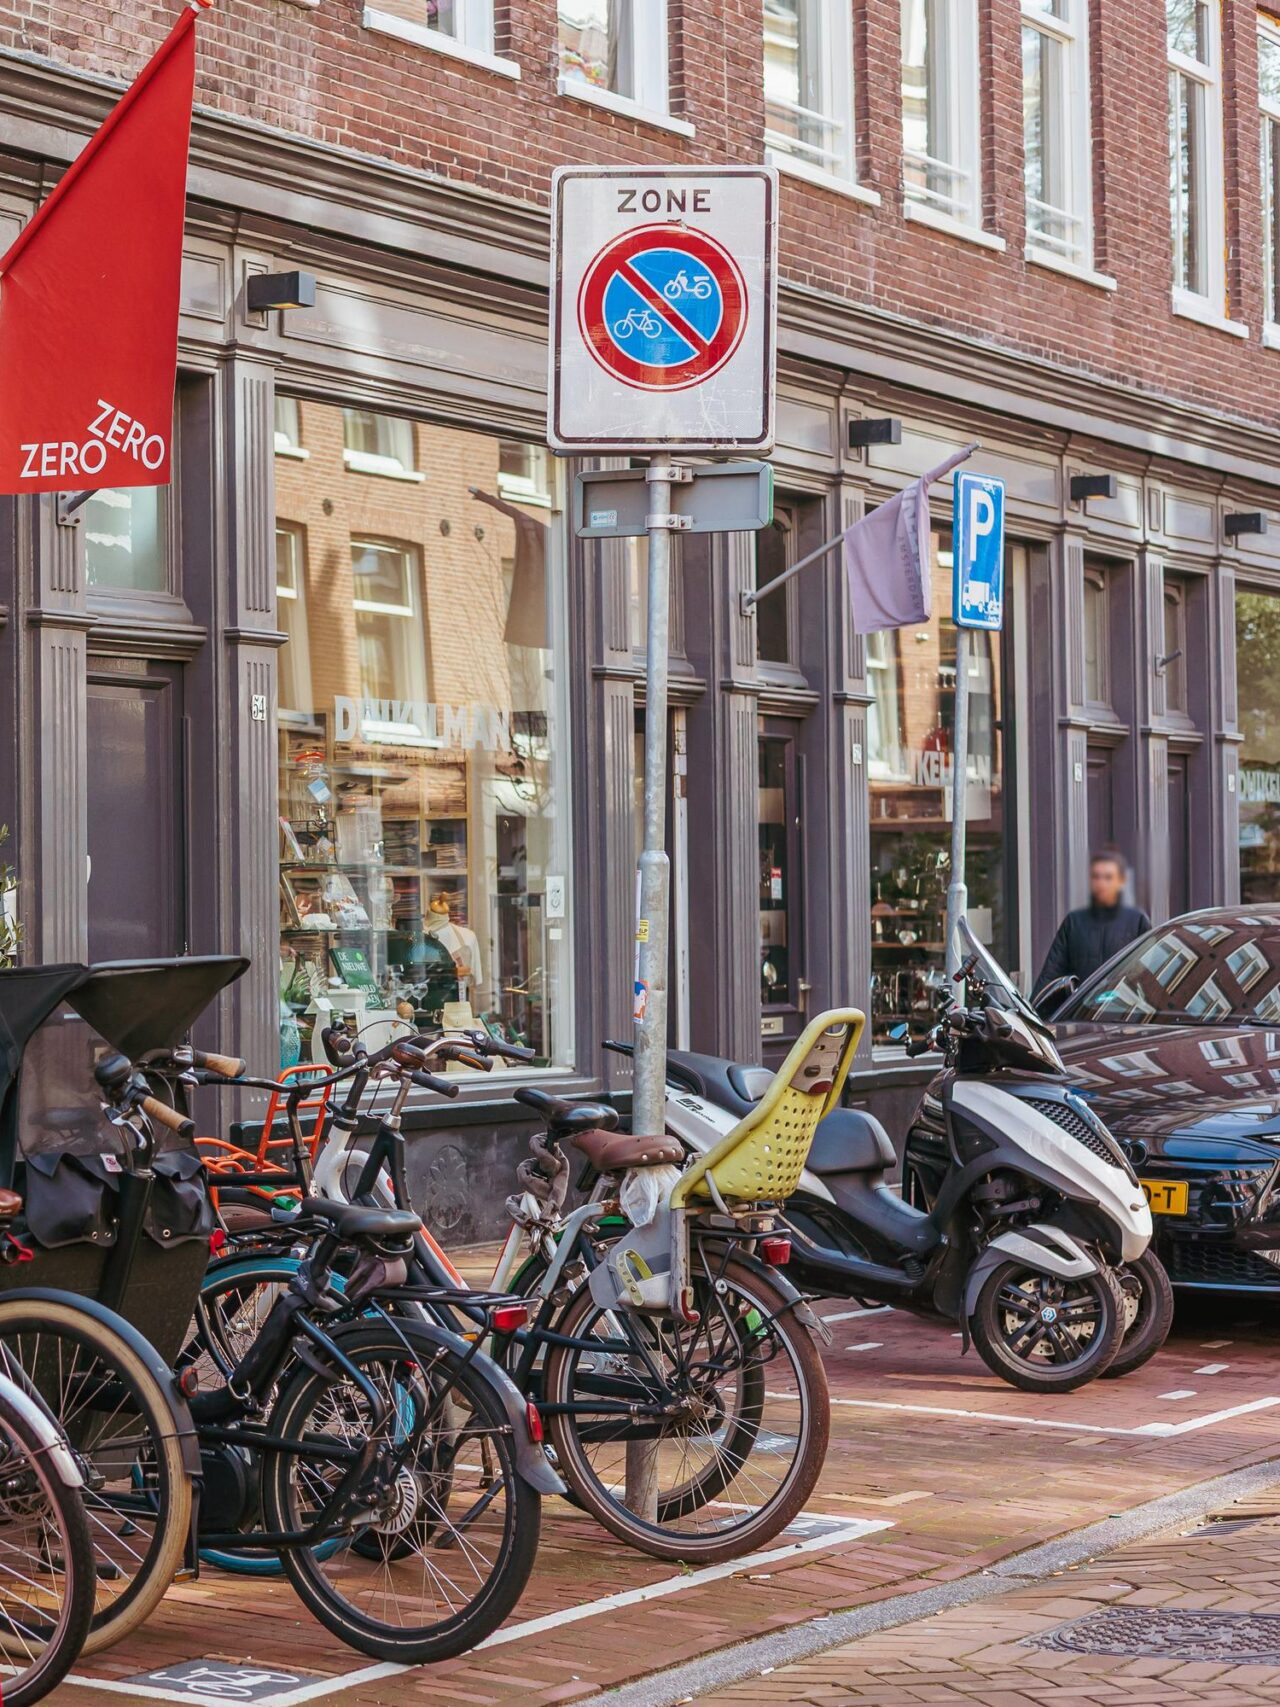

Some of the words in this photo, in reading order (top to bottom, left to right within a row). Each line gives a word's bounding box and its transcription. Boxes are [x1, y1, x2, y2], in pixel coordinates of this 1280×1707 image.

[617, 189, 711, 213] ZONE
[20, 439, 107, 478] ZERO
[87, 398, 165, 470] ZERO
[970, 489, 995, 561] P
